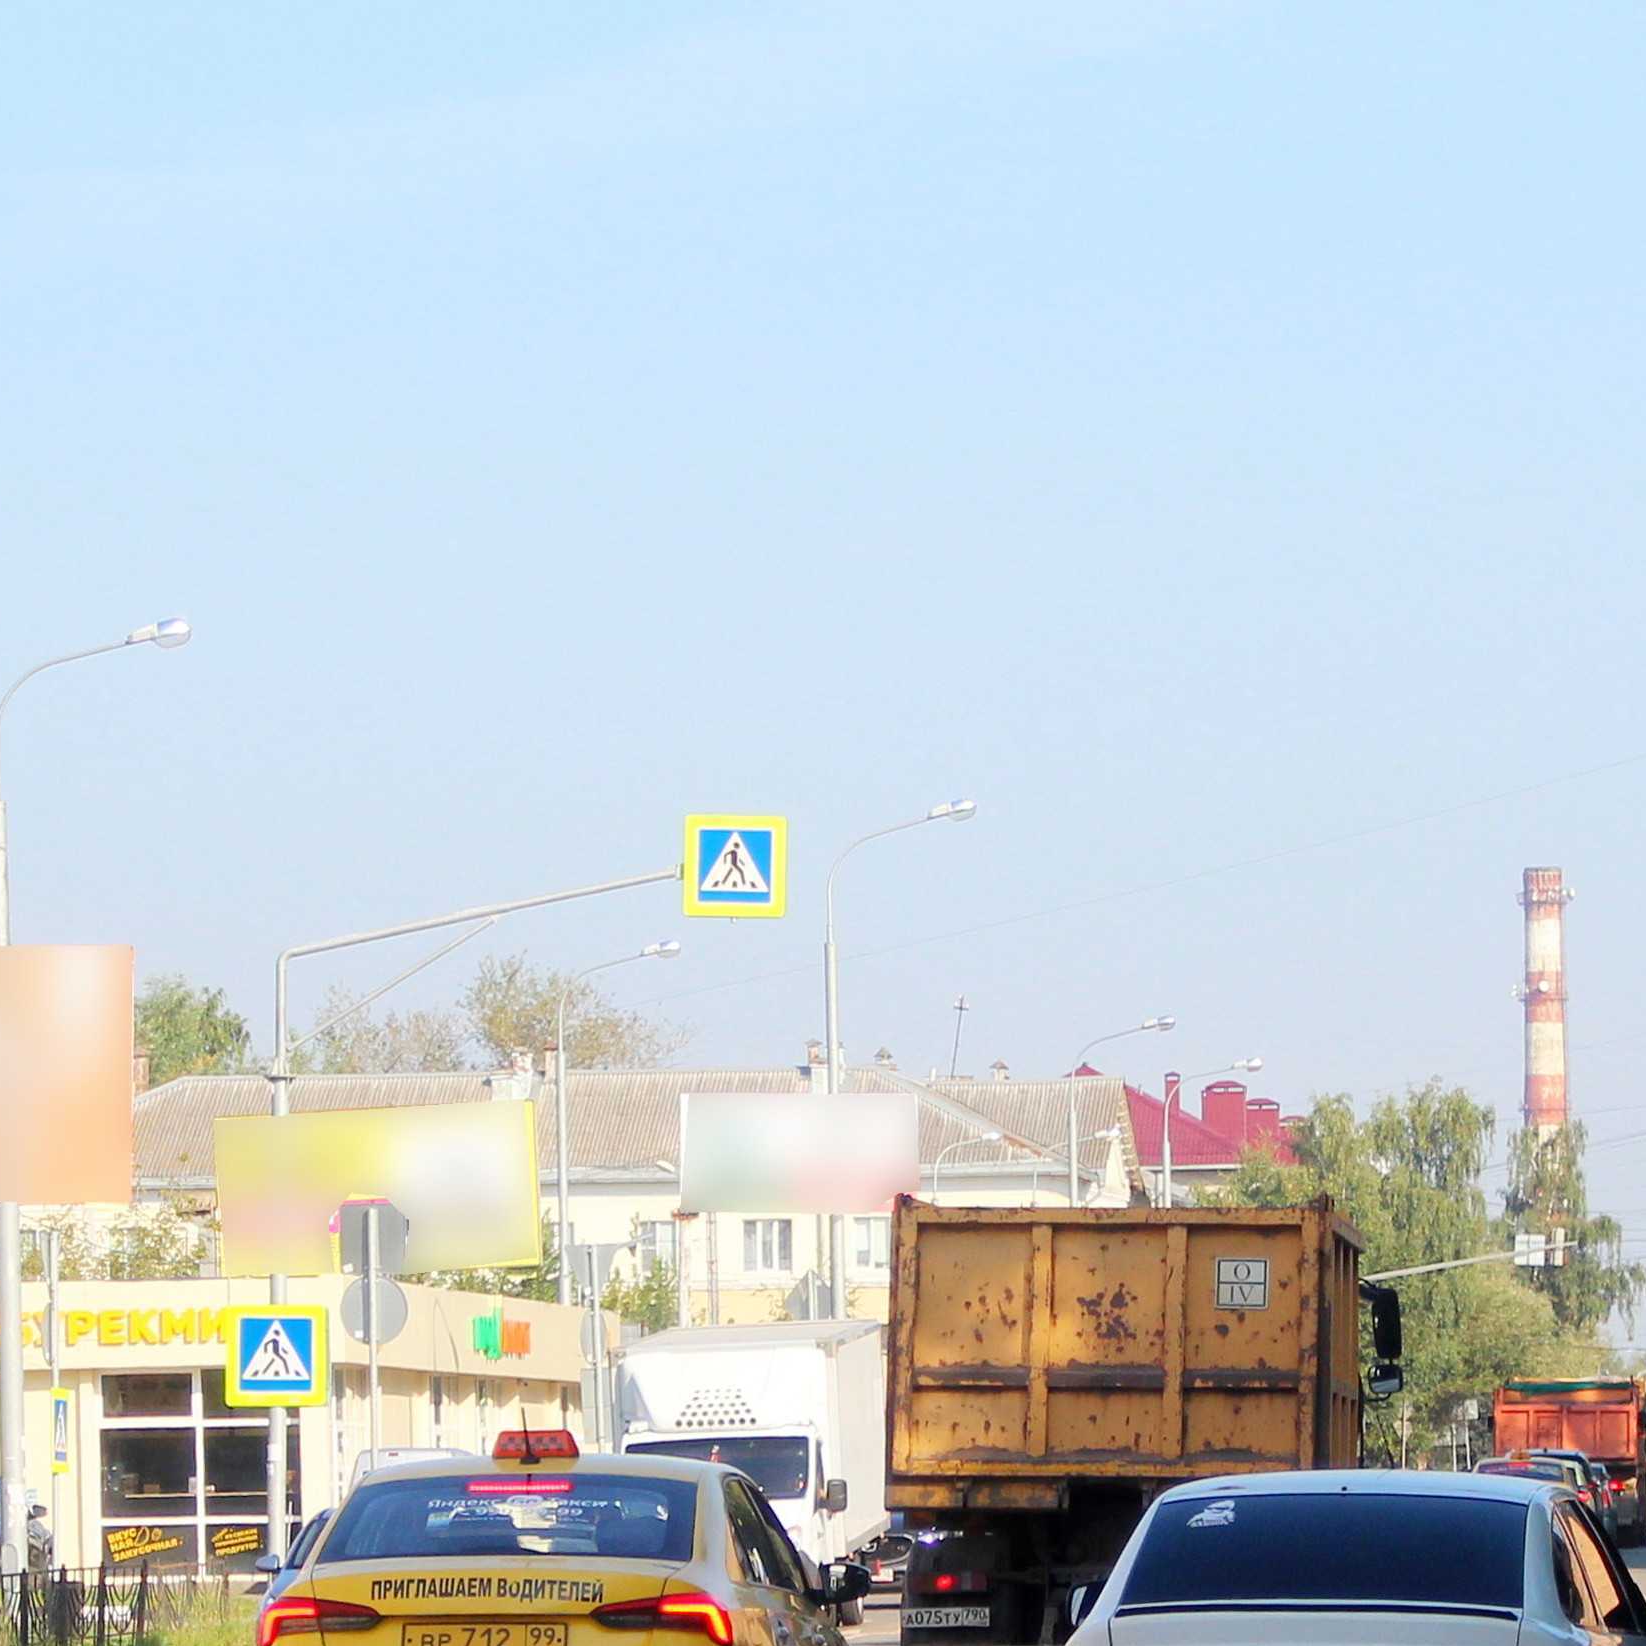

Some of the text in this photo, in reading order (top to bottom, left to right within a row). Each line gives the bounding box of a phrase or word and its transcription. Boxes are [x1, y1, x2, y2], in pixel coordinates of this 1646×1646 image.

[371, 1578, 604, 1604] ПРИГЛАШАЕМ ВОДИТЕЛЕЙ
[906, 1607, 987, 1625] А075ТУ 790
[529, 1626, 555, 1646] 99
